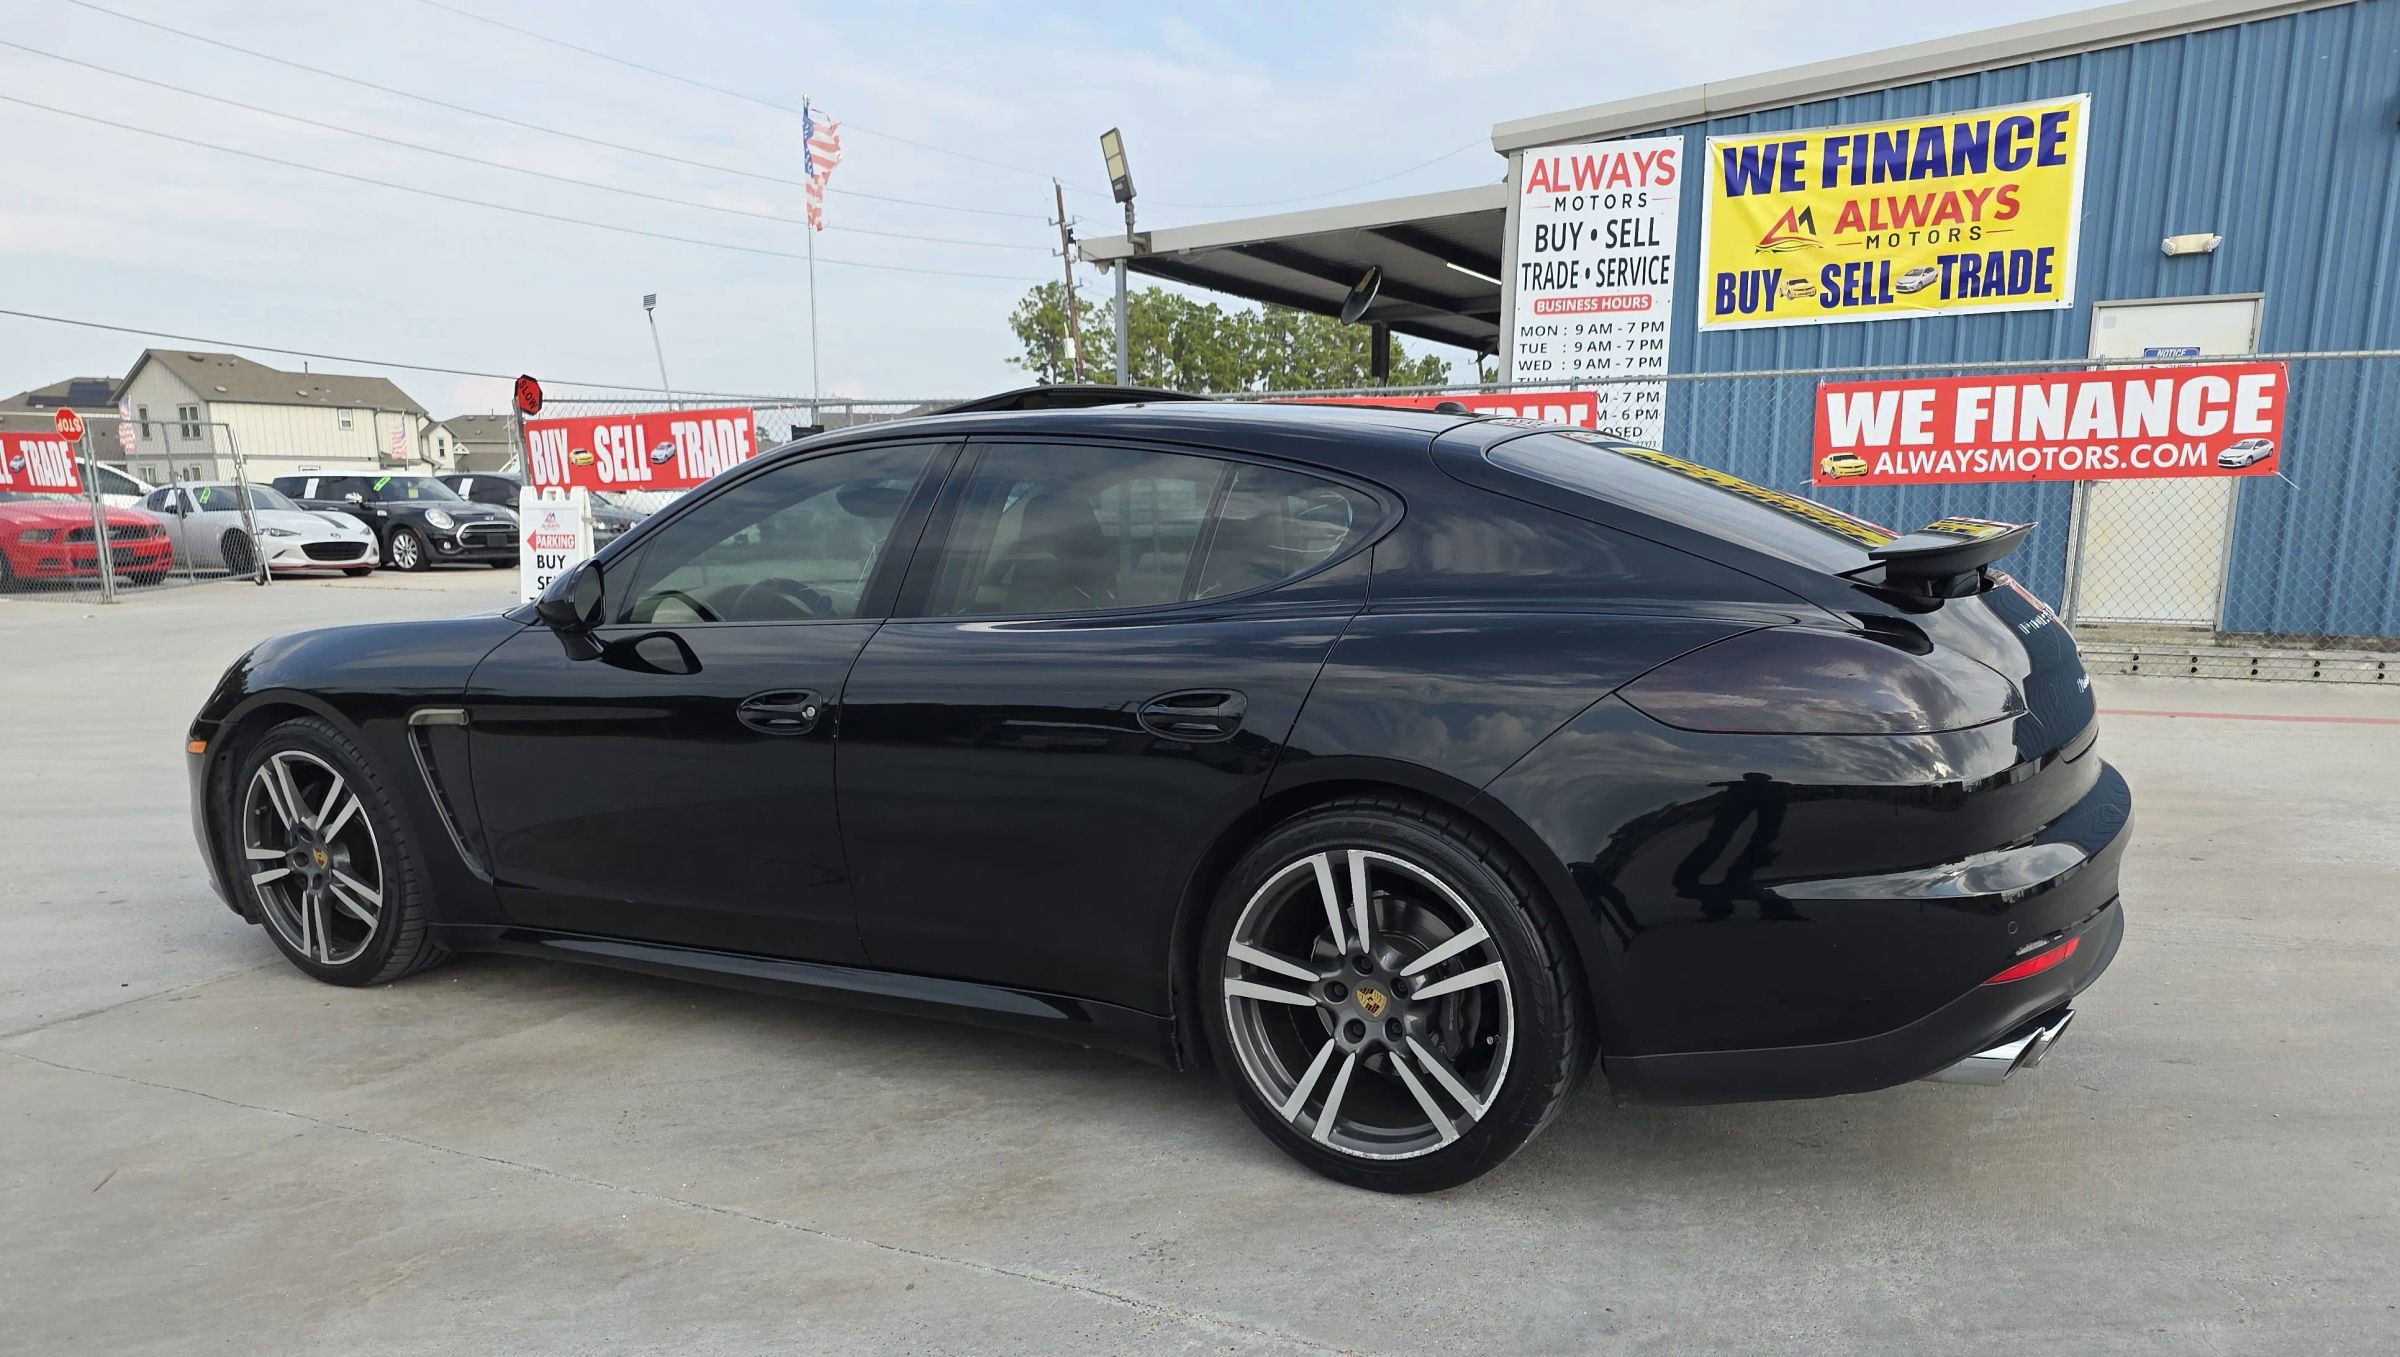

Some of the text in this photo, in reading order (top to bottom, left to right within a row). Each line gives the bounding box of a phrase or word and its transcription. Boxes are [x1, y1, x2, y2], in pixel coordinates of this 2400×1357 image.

[1723, 110, 2070, 198] WE FINANCE
[1526, 149, 1676, 194] ALWAYS
[1554, 192, 1647, 212] MOTORS
[1833, 183, 2020, 235] ALWAYS
[1535, 217, 1660, 253] BUY SELL
[1866, 226, 1982, 250] MOTORS
[1521, 254, 1671, 291] TRADE SERVICE
[1715, 247, 2054, 316] BUY SELL TRADE
[1536, 296, 1649, 313] BUSINESS HOURS
[1520, 325, 1558, 337] MON
[1575, 324, 1584, 335] 9
[1588, 323, 1613, 334] AM
[1627, 322, 1636, 334] 7
[1641, 321, 1665, 333] PM
[1519, 343, 1548, 354] TUE
[1574, 341, 1583, 353] 9
[1587, 341, 1612, 352] AM
[1626, 340, 1635, 351] 7
[1640, 339, 1664, 350] PM
[2157, 348, 2187, 357] NOTICE
[1518, 360, 1552, 371] WED
[1573, 359, 1582, 370] 9
[1586, 358, 1611, 369] AM
[1625, 357, 1634, 368] 7
[1638, 356, 1663, 368] PM
[520, 380, 538, 409] SLOW
[1623, 392, 1632, 403] 7
[1636, 391, 1660, 403] PM
[1621, 409, 1630, 420] 6
[1635, 409, 1659, 420] PM
[1826, 373, 2277, 448] WE FINANCE
[57, 418, 82, 432] STOP
[19, 440, 77, 487] TRADE
[528, 418, 750, 485] BUY SELL TRADE
[1873, 442, 2208, 476] ALWAYSMOTORS.COM
[535, 534, 575, 549] PARKING
[536, 554, 566, 569] BUY
